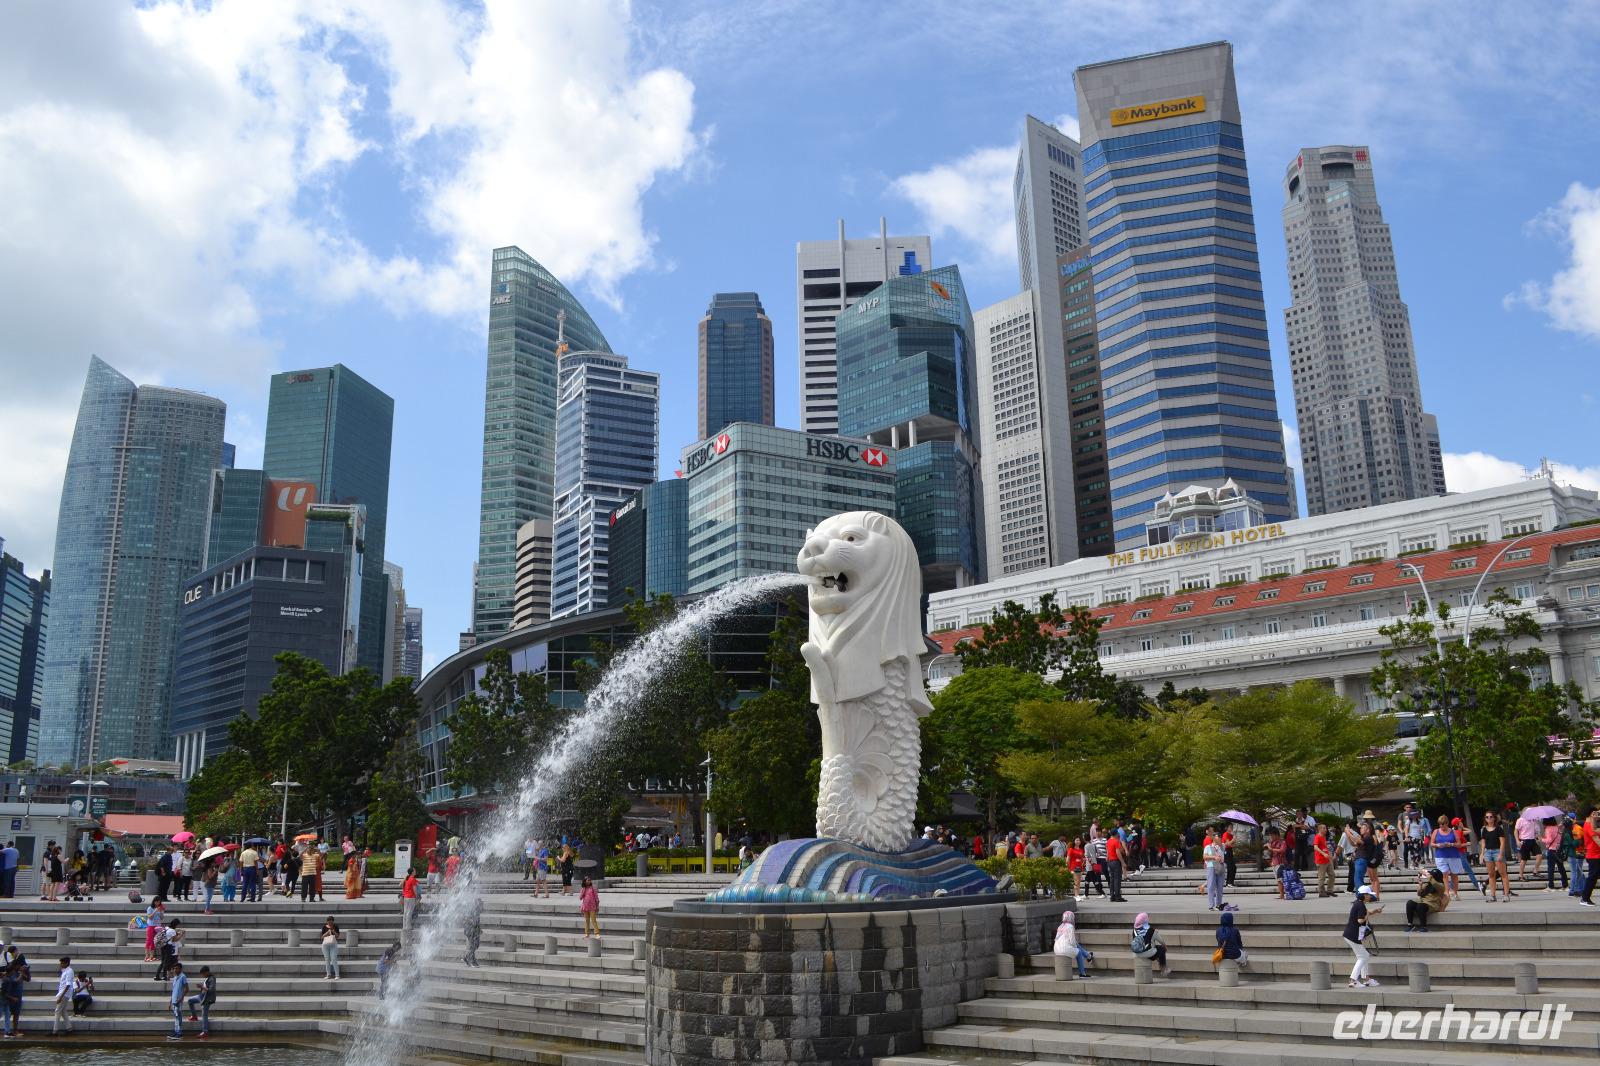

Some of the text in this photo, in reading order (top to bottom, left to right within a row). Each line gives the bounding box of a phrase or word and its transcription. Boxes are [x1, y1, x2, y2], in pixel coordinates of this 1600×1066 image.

[1131, 99, 1196, 118] Maybank
[492, 295, 511, 305] ANZ
[858, 298, 879, 314] MYP
[686, 441, 714, 474] HSBC
[806, 438, 860, 463] HSBC
[1107, 523, 1286, 567] THE FULLERTON HOTEL
[184, 585, 202, 605] OUE
